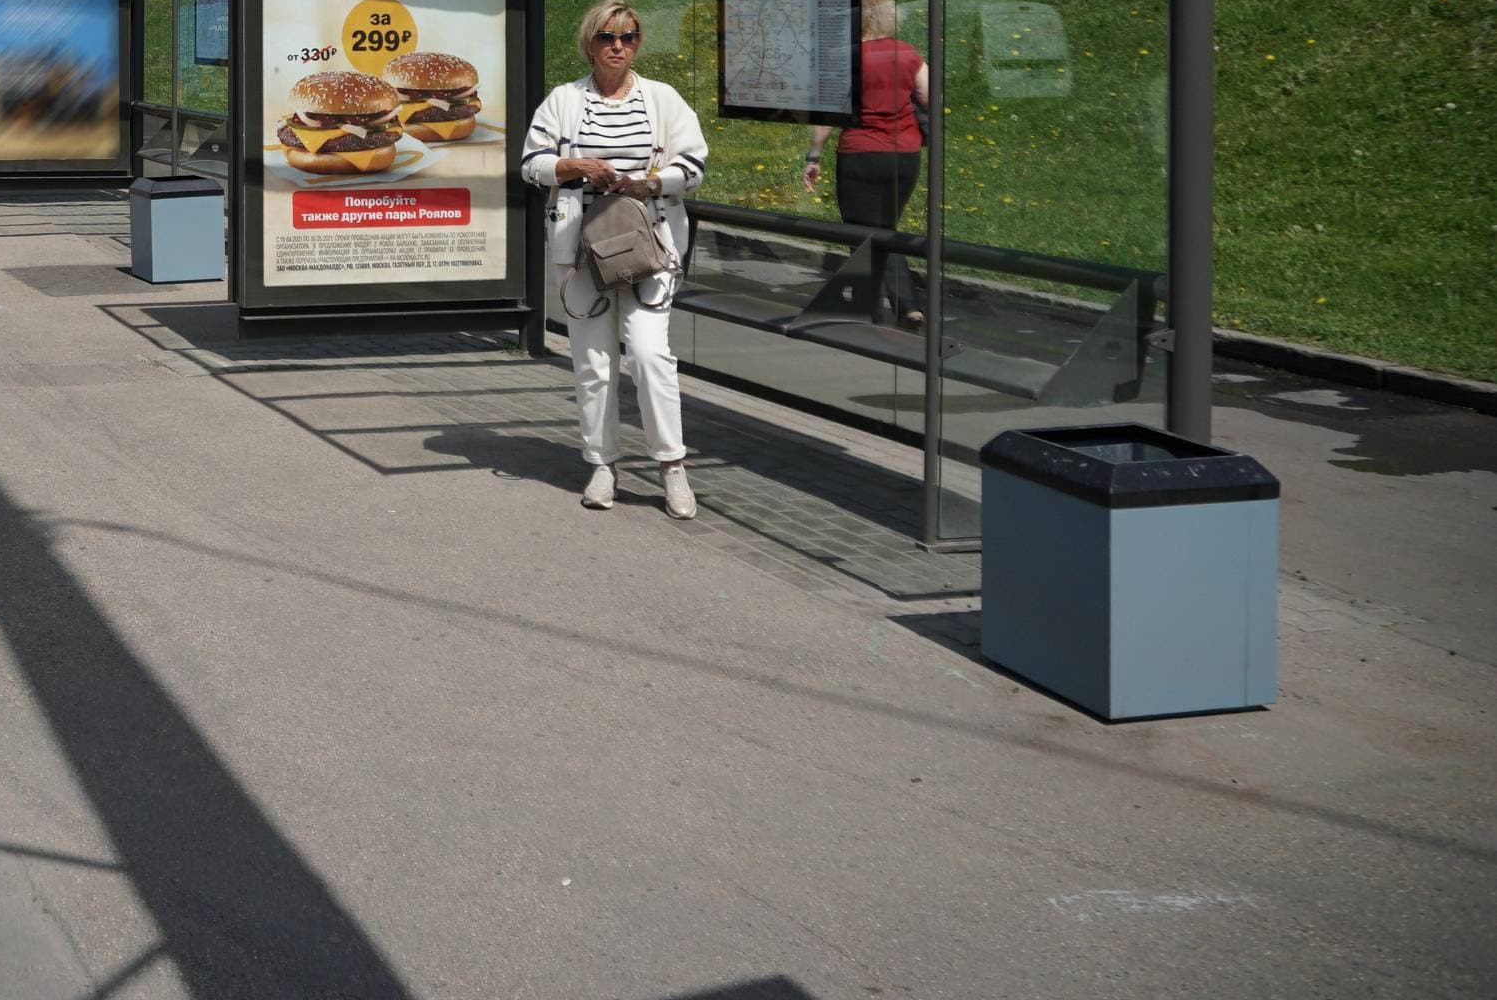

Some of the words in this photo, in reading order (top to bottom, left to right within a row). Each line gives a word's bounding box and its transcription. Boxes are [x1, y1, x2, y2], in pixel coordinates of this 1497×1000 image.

[369, 13, 392, 26] за
[287, 53, 299, 62] от
[344, 195, 417, 209] Попробуйте
[301, 211, 340, 222] также
[341, 210, 383, 224] другие
[385, 209, 417, 222] пары
[419, 208, 462, 220] Роялов
